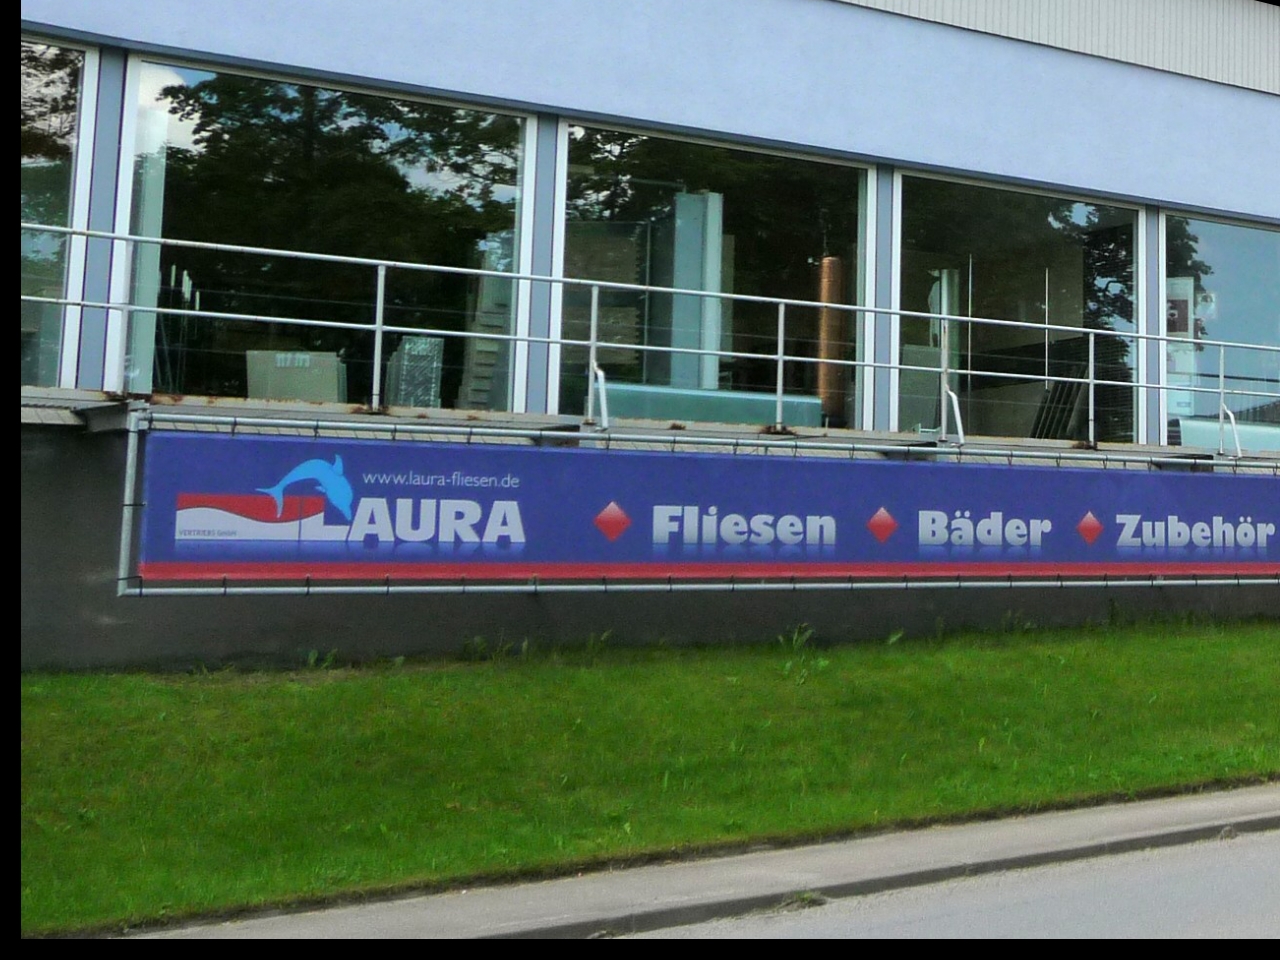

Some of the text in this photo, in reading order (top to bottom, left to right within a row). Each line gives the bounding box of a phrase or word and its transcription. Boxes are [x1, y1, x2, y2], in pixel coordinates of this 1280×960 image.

[362, 470, 520, 489] www.laura-fliesen.de
[300, 496, 526, 543] LAURA
[651, 505, 1276, 548] Fliesen Bäder Zubehör
